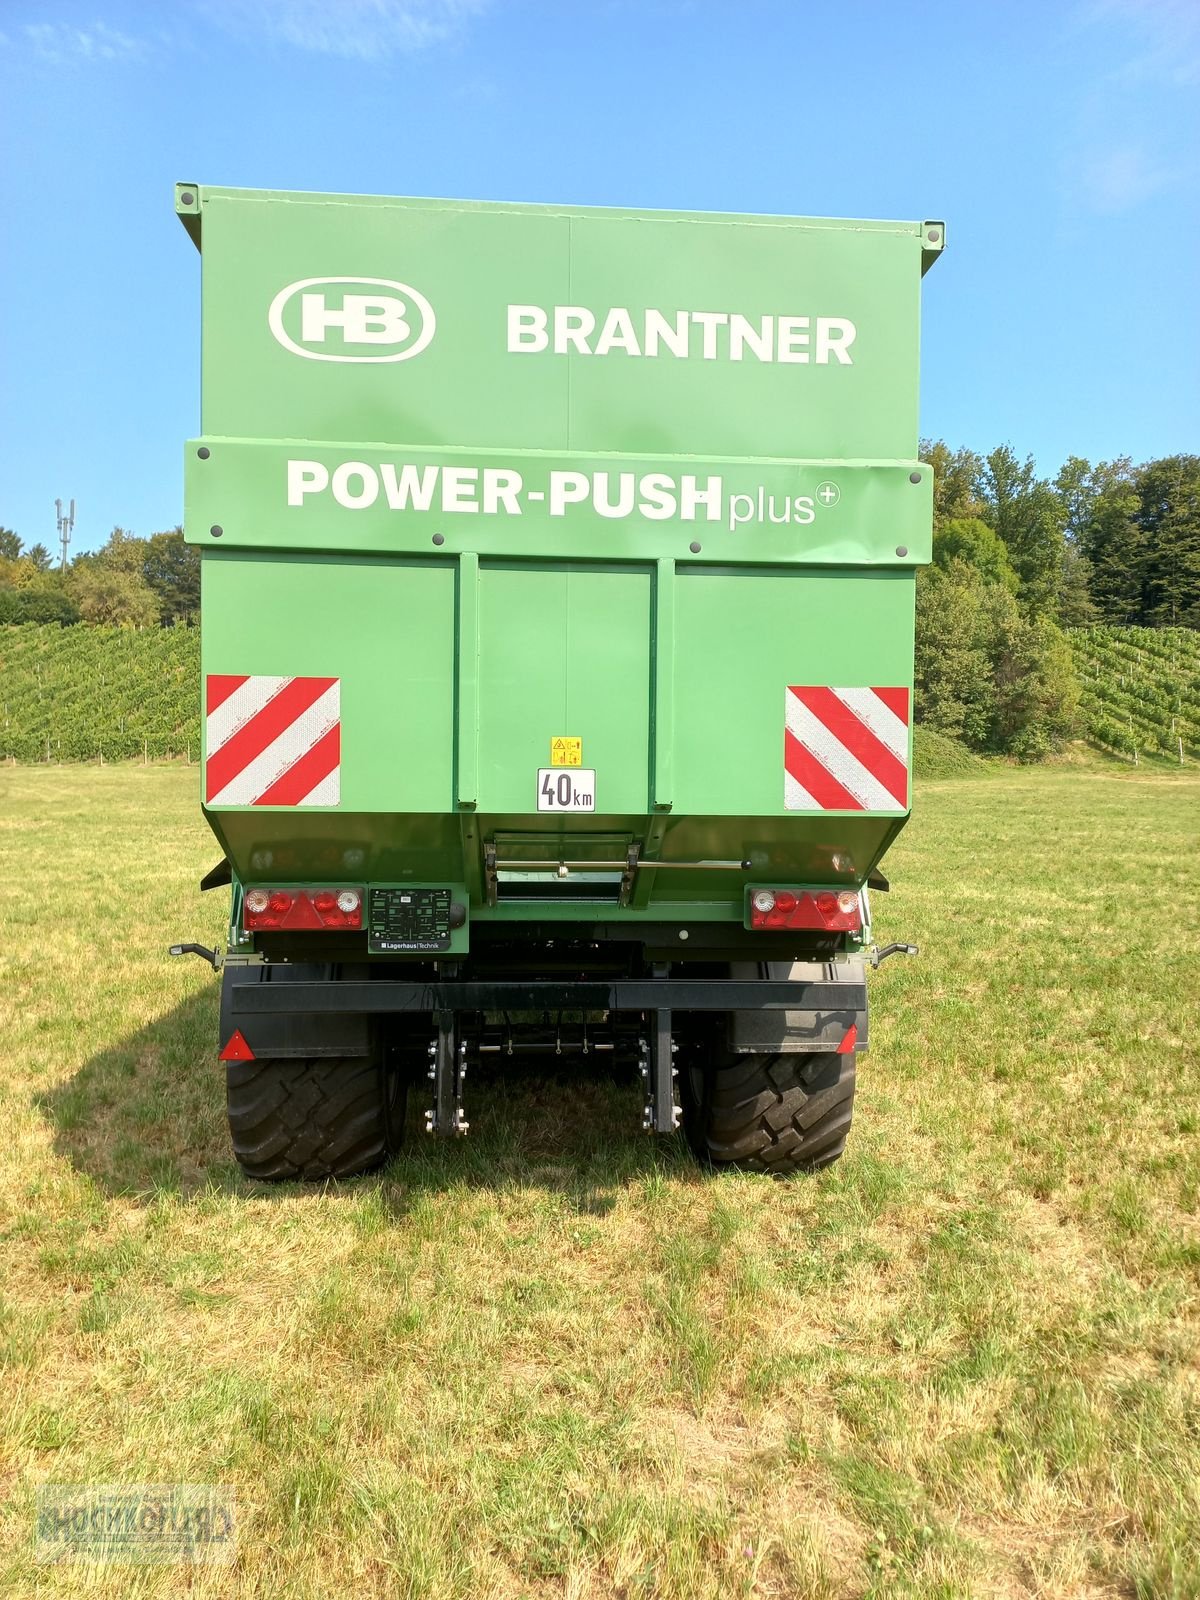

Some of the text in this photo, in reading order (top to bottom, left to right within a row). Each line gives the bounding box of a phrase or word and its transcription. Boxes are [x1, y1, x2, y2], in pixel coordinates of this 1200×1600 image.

[301, 293, 411, 345] HB
[507, 303, 857, 366] BRANTNER
[287, 459, 723, 521] POWER-PUSH
[541, 773, 592, 806] 40 km
[387, 942, 417, 950] Lagerhaus
